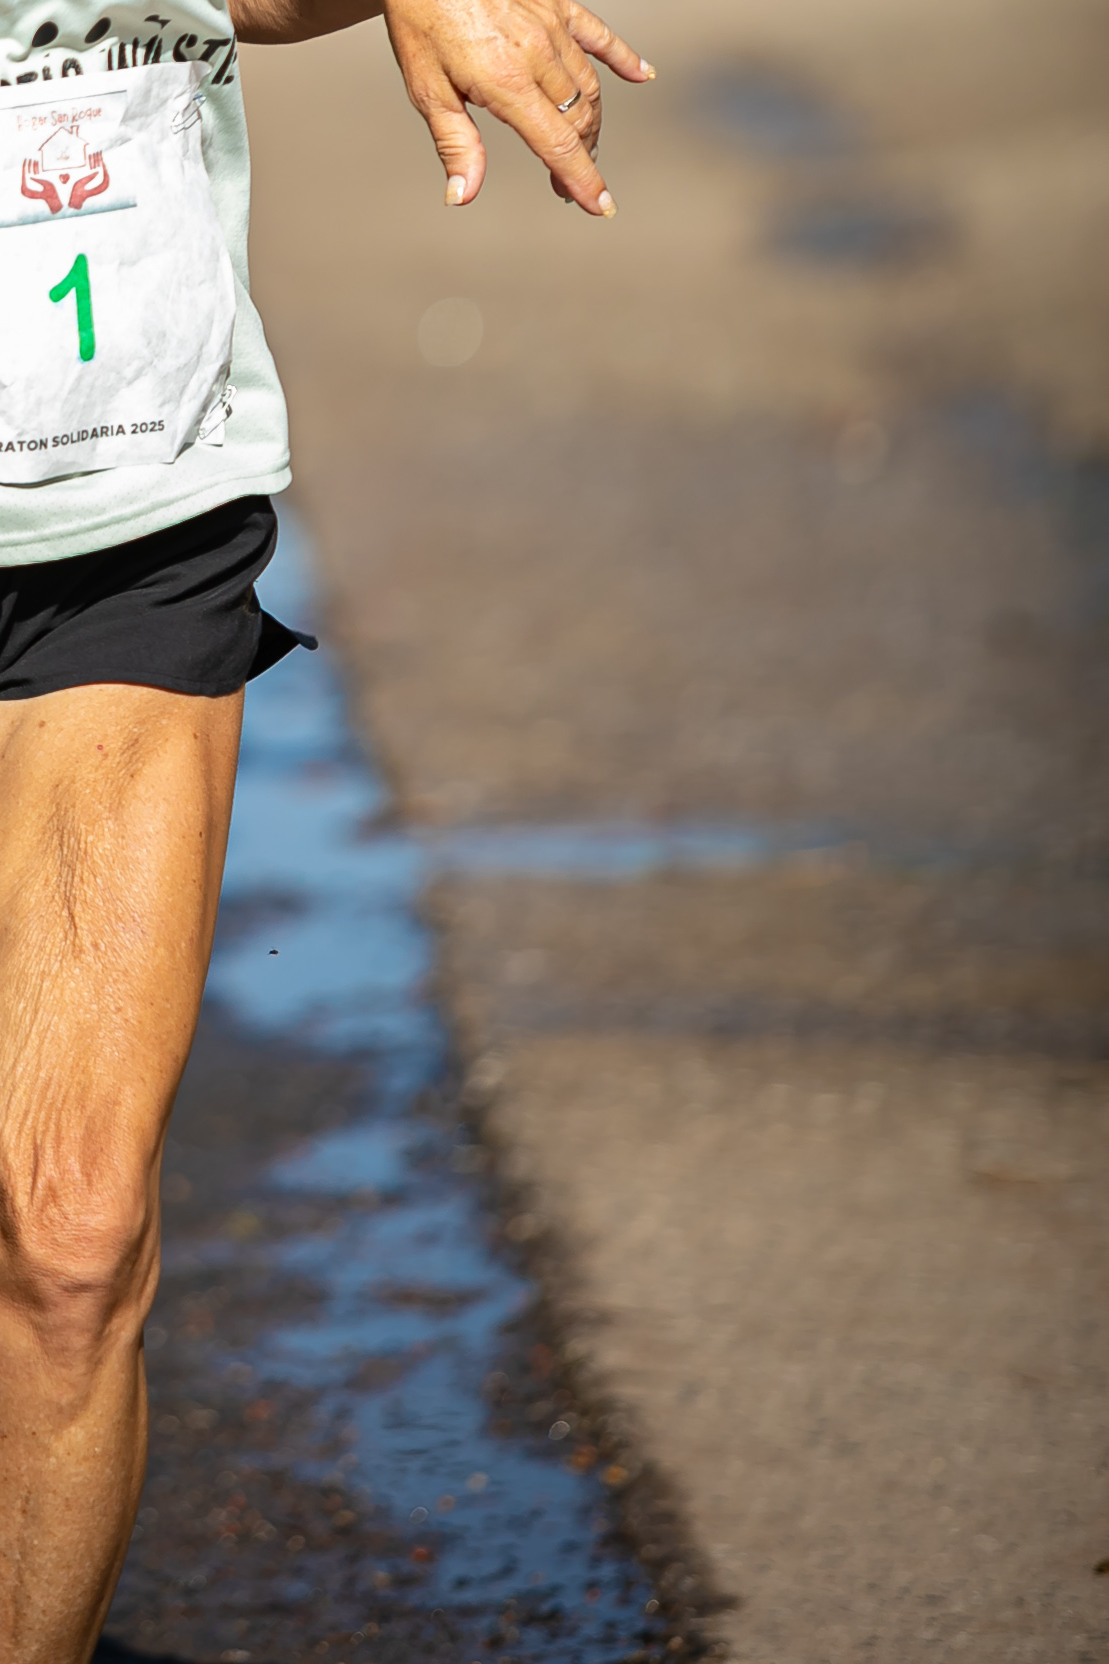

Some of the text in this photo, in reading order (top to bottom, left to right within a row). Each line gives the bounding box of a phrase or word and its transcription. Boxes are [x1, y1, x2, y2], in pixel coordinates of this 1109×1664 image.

[50, 110, 70, 127] San
[71, 106, 103, 125] Roque
[49, 253, 95, 362] 1
[51, 423, 127, 448] SOLIDARIA
[130, 419, 166, 435] 2025
